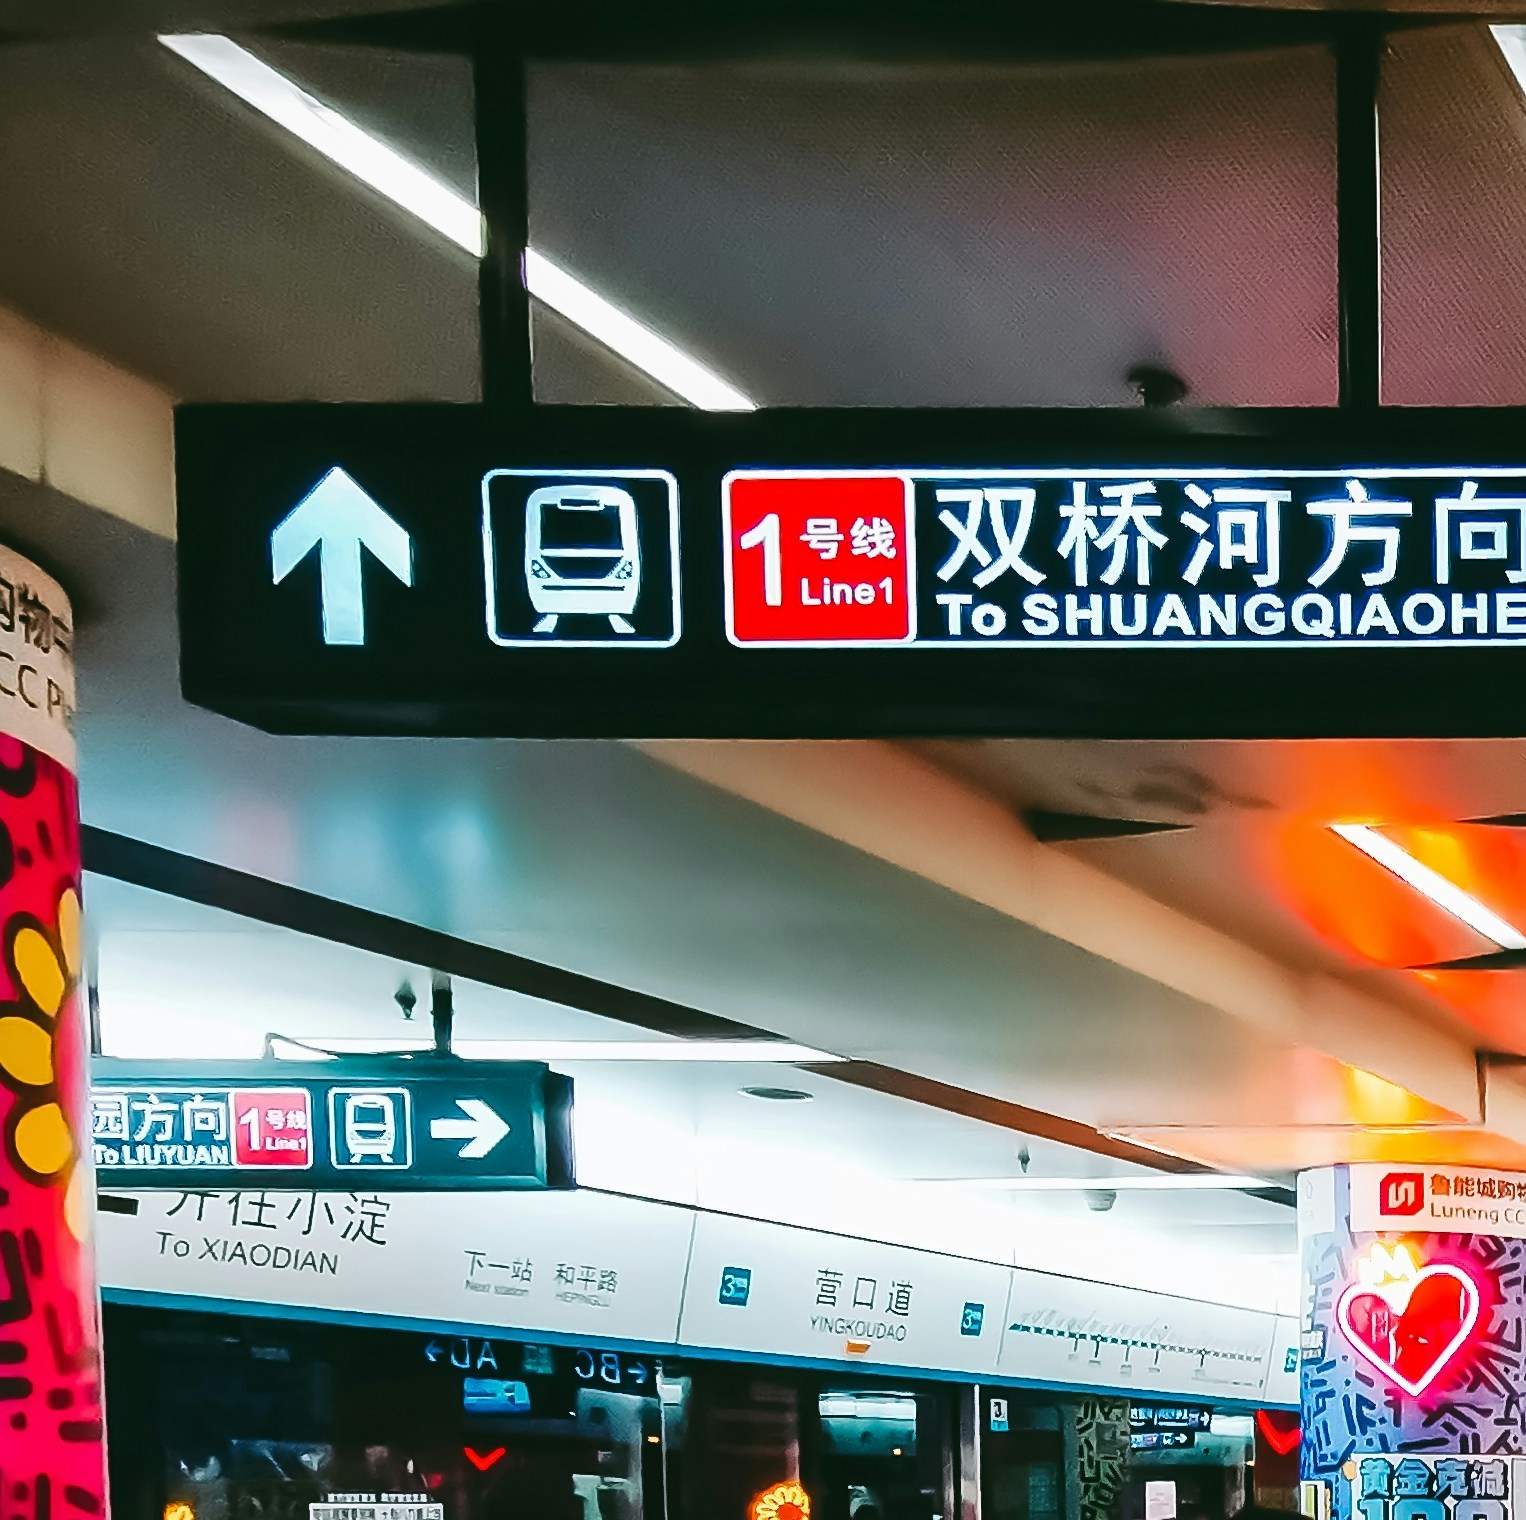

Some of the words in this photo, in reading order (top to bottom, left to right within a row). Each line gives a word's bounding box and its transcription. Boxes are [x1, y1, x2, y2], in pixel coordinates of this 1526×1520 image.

[800, 517, 897, 559] 号线
[740, 513, 782, 607] 1
[801, 578, 894, 606] Line1
[936, 594, 1006, 636] To
[122, 1143, 229, 1165] LIUYUAN
[1430, 1202, 1499, 1225] Luneng
[1504, 1207, 1526, 1225] CC
[156, 1231, 190, 1258] To
[198, 1237, 338, 1276] XIAODIAN
[464, 1250, 533, 1283] 下一站
[815, 1267, 914, 1317] 营口道
[809, 1315, 908, 1342] YINGKOUDAO
